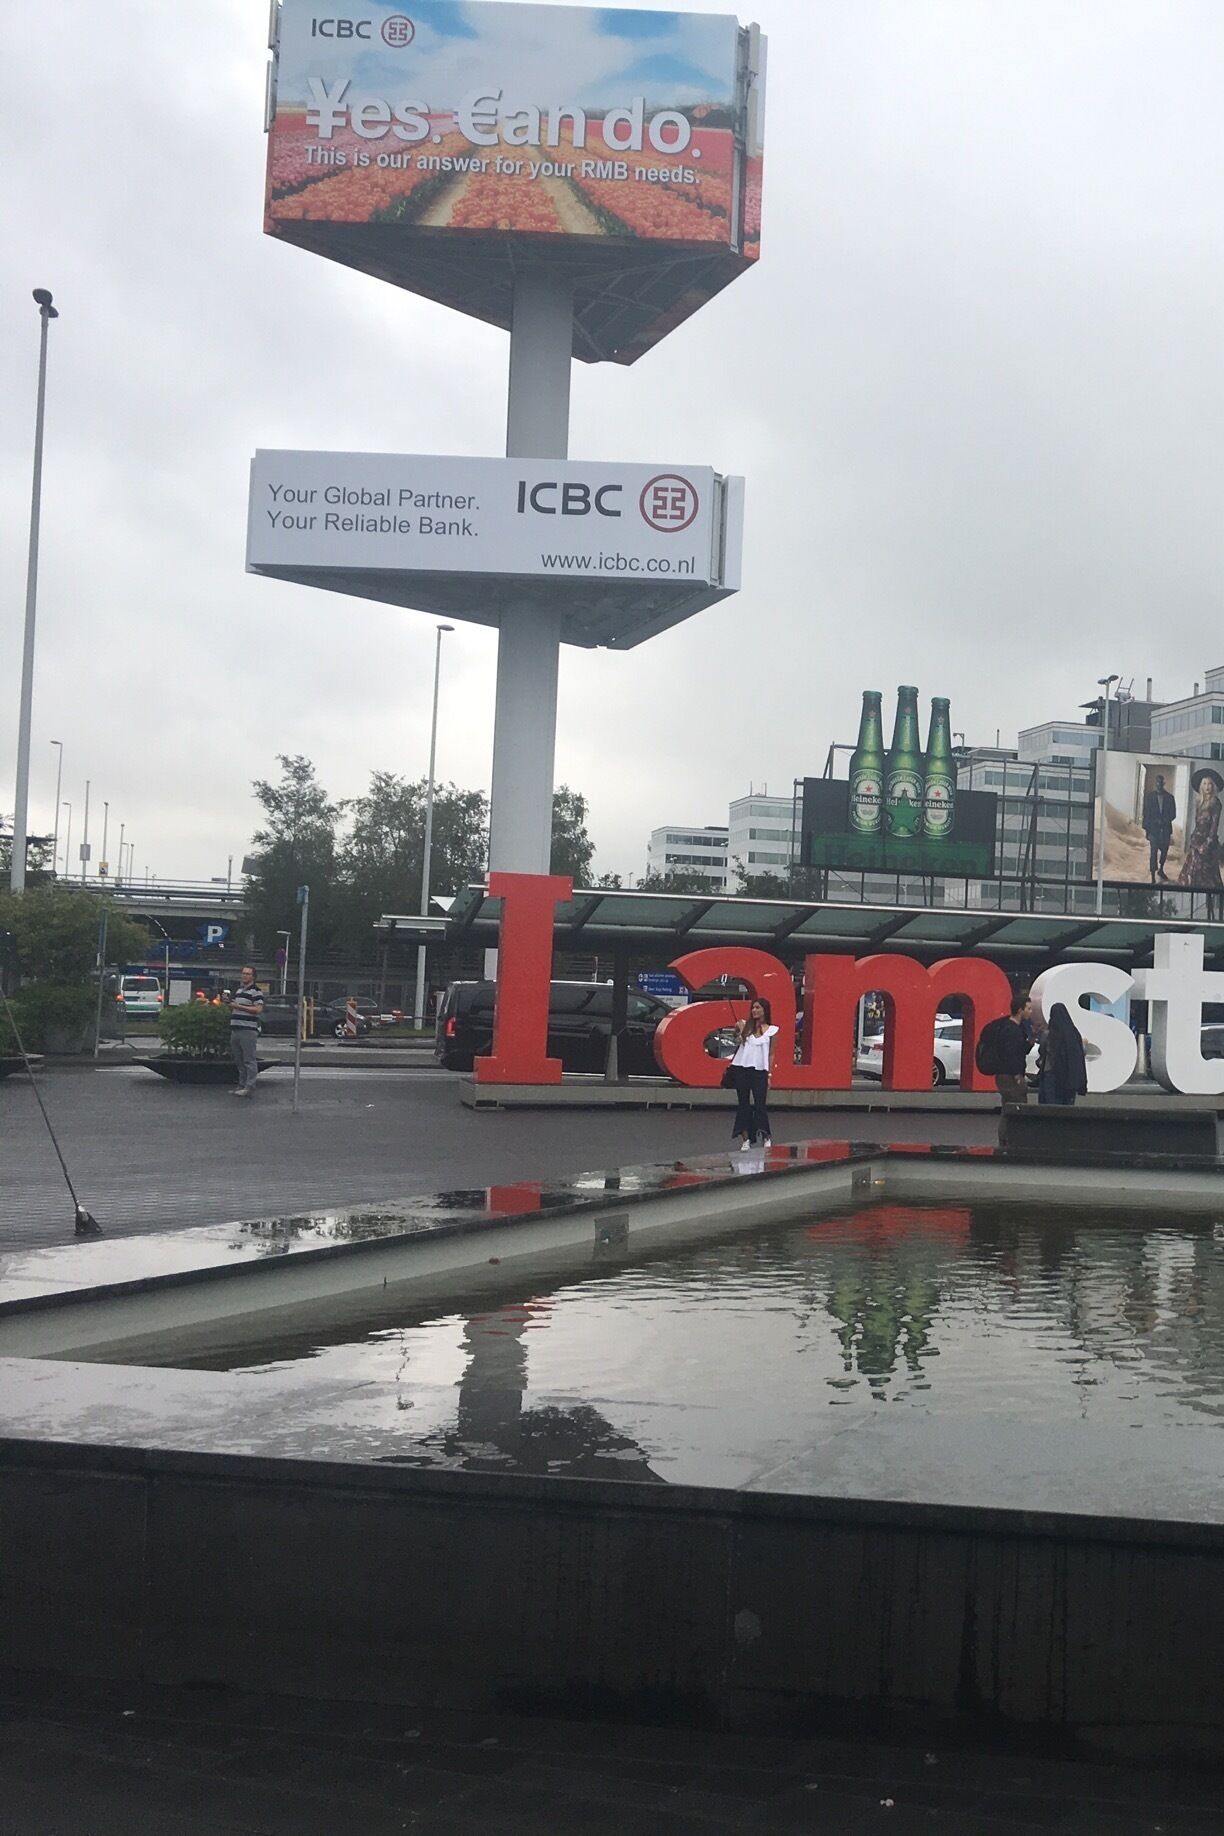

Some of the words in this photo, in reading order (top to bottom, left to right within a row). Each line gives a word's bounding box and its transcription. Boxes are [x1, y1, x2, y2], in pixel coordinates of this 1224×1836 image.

[310, 18, 372, 40] ICBC
[602, 96, 702, 158] do.
[304, 146, 347, 166] This
[353, 147, 370, 167] is
[377, 153, 413, 171] our
[416, 155, 492, 174] answer
[495, 155, 525, 175] for
[527, 161, 576, 182] your
[580, 159, 629, 180] RMB
[634, 164, 701, 185] needs.
[268, 484, 317, 505] Your
[324, 486, 391, 507] Global
[398, 489, 481, 510] Partner.
[517, 481, 623, 517] ICBC
[266, 510, 316, 530] Your
[324, 512, 411, 534] Reliable
[419, 517, 479, 537] Bank.
[541, 552, 695, 575] www.icbc.co.nl
[207, 925, 223, 943] P
[474, 872, 573, 1084] I
